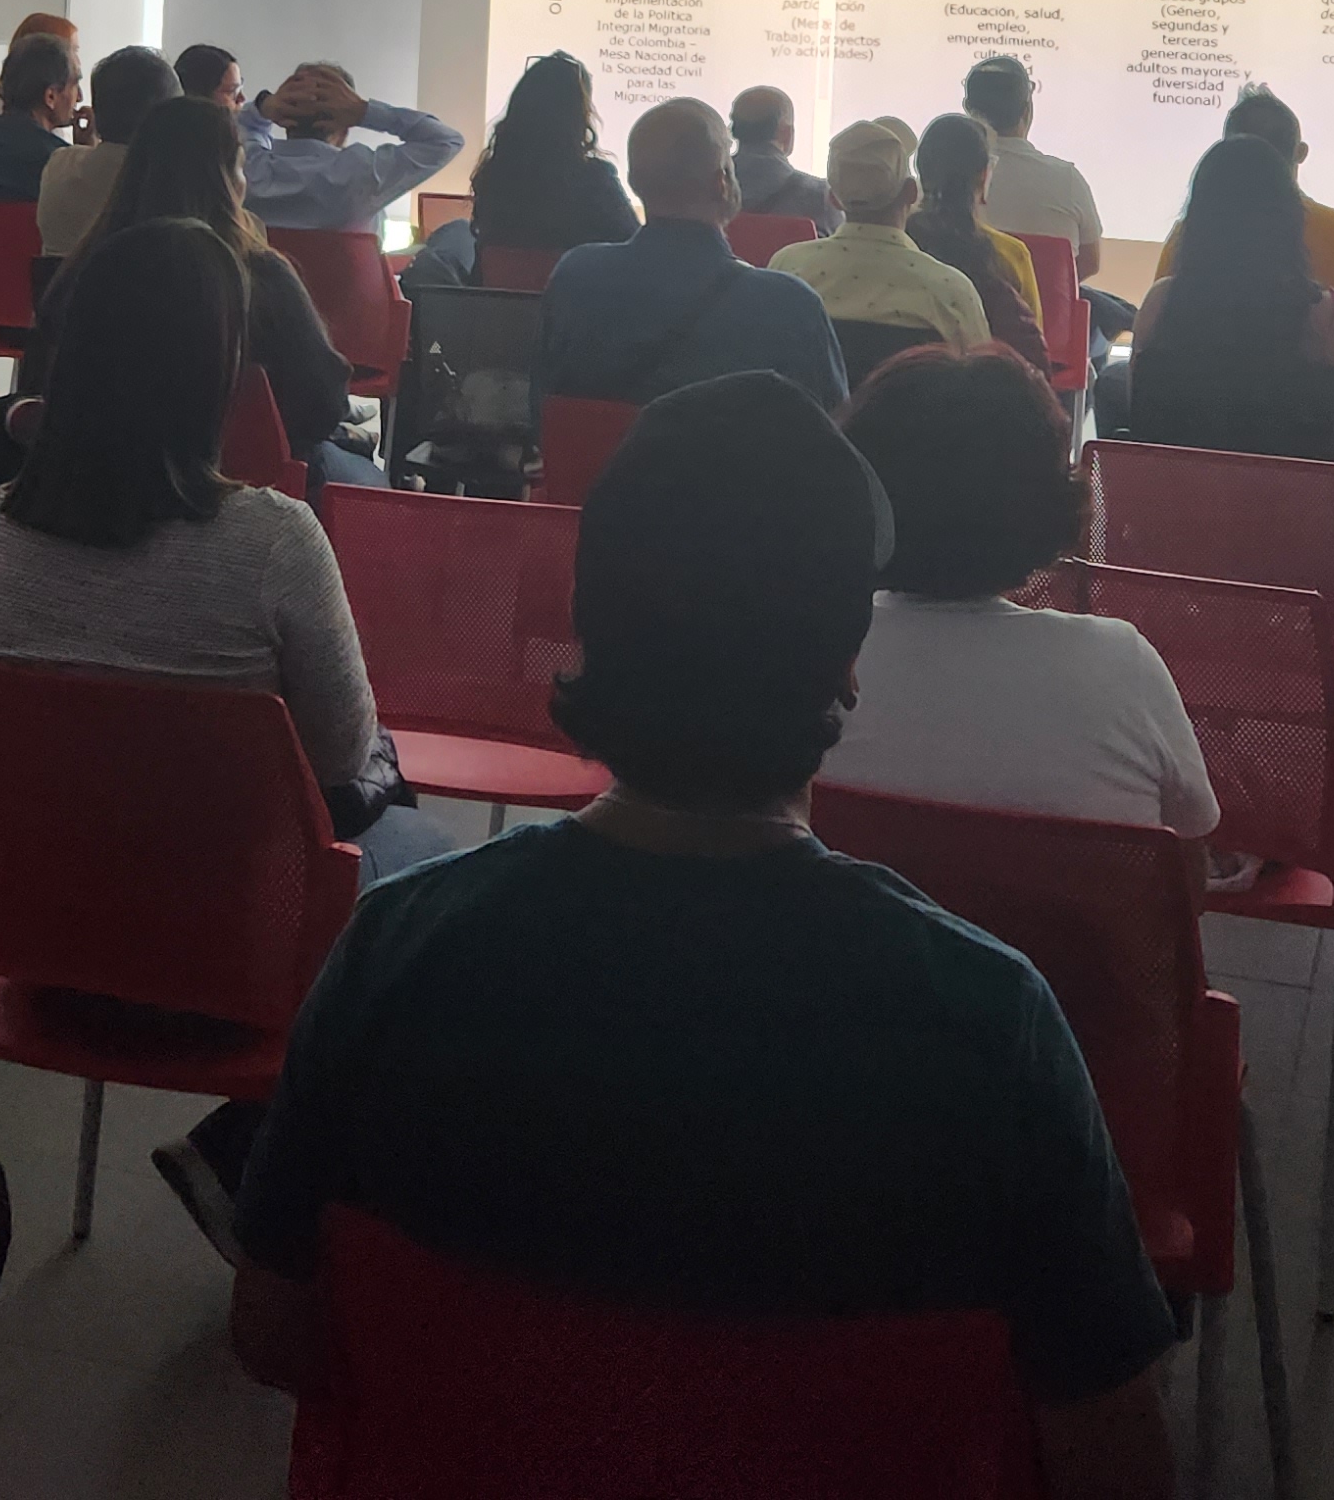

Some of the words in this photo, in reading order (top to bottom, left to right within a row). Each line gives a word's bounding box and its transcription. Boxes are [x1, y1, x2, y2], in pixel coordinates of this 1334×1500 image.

[614, 8, 629, 19] de
[634, 9, 644, 19] la
[648, 9, 693, 21] Política
[944, 3, 1019, 19] (Educación,
[1024, 8, 1065, 21] salud,
[1160, 4, 1221, 20] (Género,
[597, 20, 645, 34] Integral
[649, 23, 711, 36] Migratoria
[839, 19, 855, 31] de
[977, 21, 1030, 34] empleo,
[1151, 19, 1218, 33] segundas
[1221, 24, 1230, 35] y
[609, 36, 624, 46] de
[628, 36, 685, 49] Colombia
[765, 30, 816, 45] Trabajo,
[947, 34, 1059, 51] emprendimiento,
[1162, 34, 1219, 48] terceras
[599, 49, 630, 60] Mesa
[635, 50, 687, 62] Nacional
[690, 53, 706, 63] de
[770, 45, 792, 57] y/o
[1023, 53, 1032, 62] e
[1141, 49, 1238, 65] generaciones,
[602, 63, 613, 73] la
[617, 63, 672, 76] Sociedad
[676, 65, 702, 77] Civil
[1126, 62, 1178, 75] adultos
[1181, 67, 1240, 79] mayores
[1243, 70, 1252, 81] y
[627, 78, 654, 89] para
[658, 79, 676, 89] las
[1152, 77, 1224, 92] diversidad
[1152, 92, 1222, 109] funcional)
